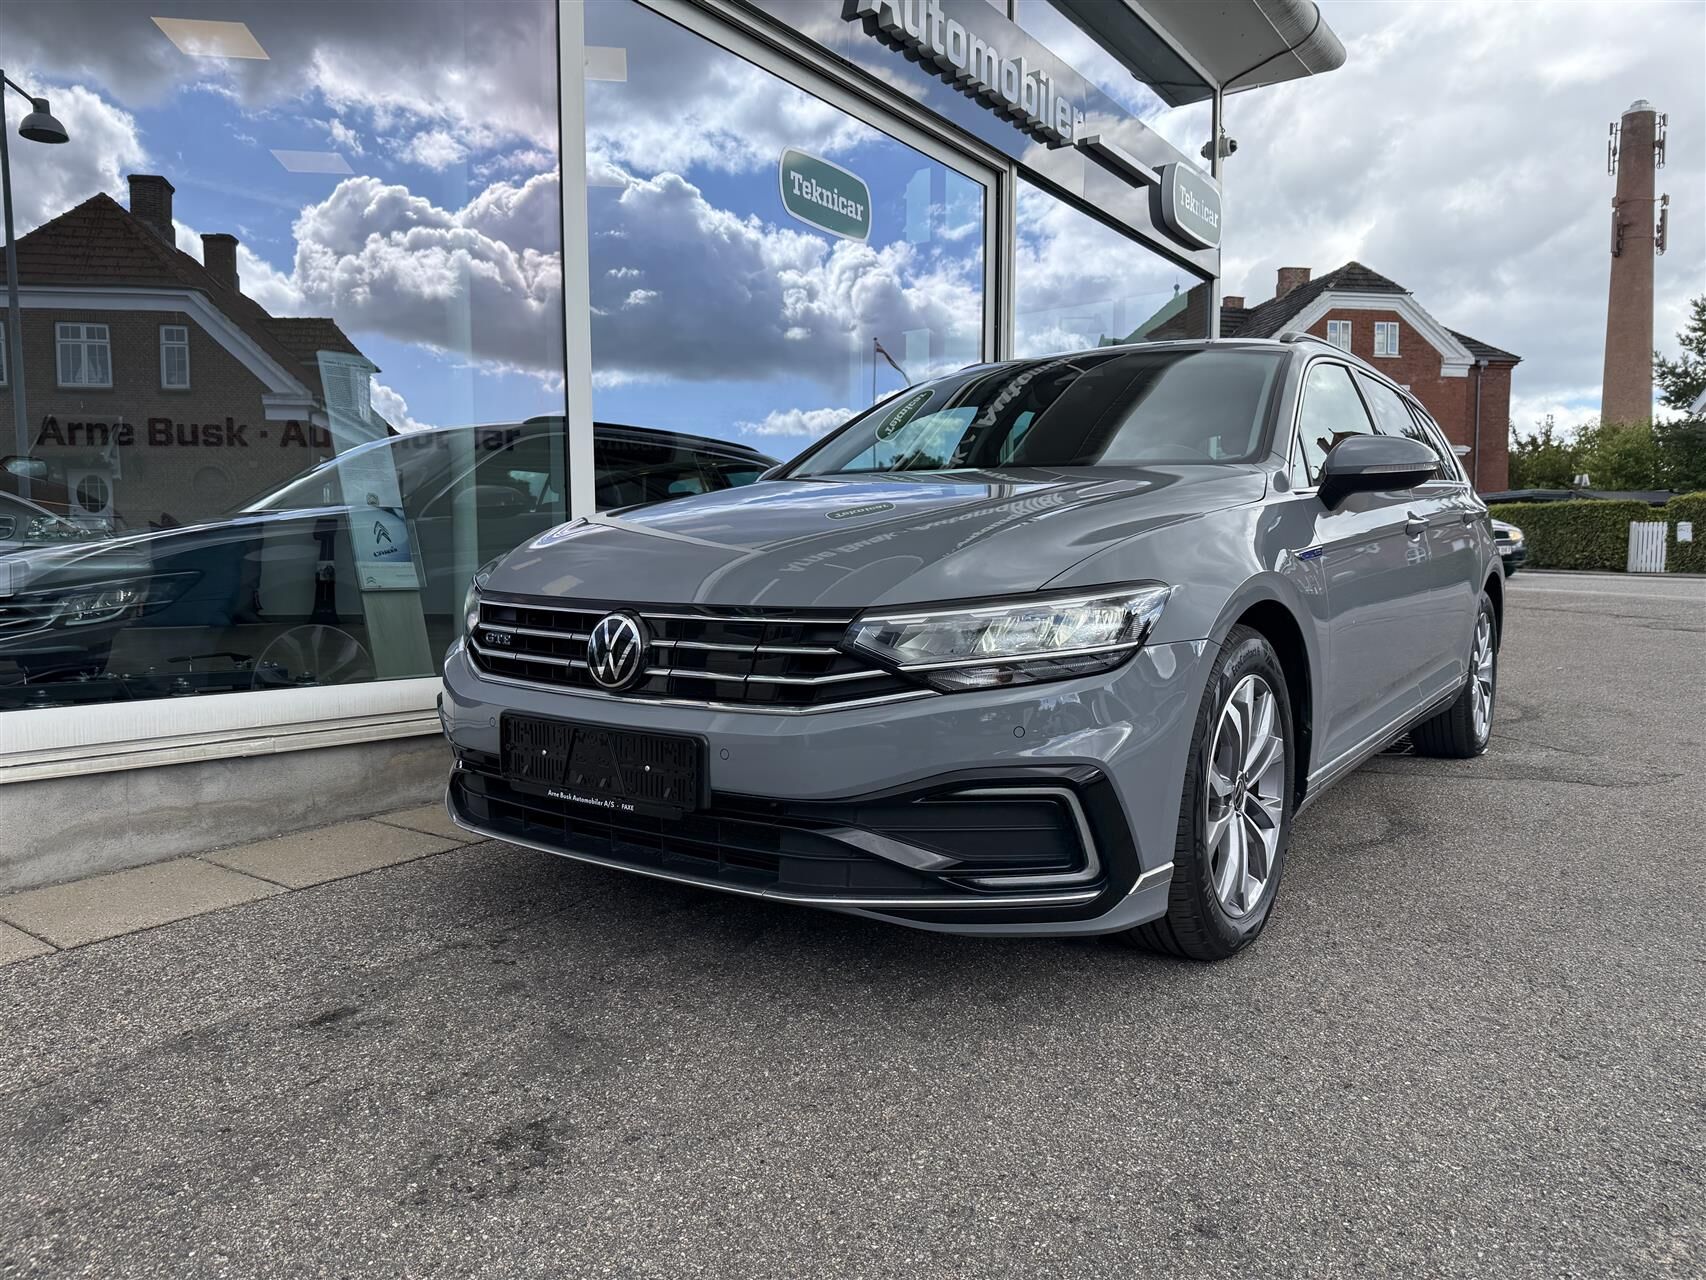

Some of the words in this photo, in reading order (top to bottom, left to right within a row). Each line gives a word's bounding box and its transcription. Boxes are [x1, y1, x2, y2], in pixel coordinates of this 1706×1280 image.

[790, 170, 864, 222] Teknicar
[1180, 184, 1219, 229] Teknicar
[36, 415, 135, 447] Arne
[148, 417, 249, 448] Busk
[485, 631, 511, 646] GTE
[547, 789, 560, 798] Arne
[572, 794, 604, 806] Automobiler
[603, 800, 615, 809] A/S
[621, 803, 635, 811] FAXE
